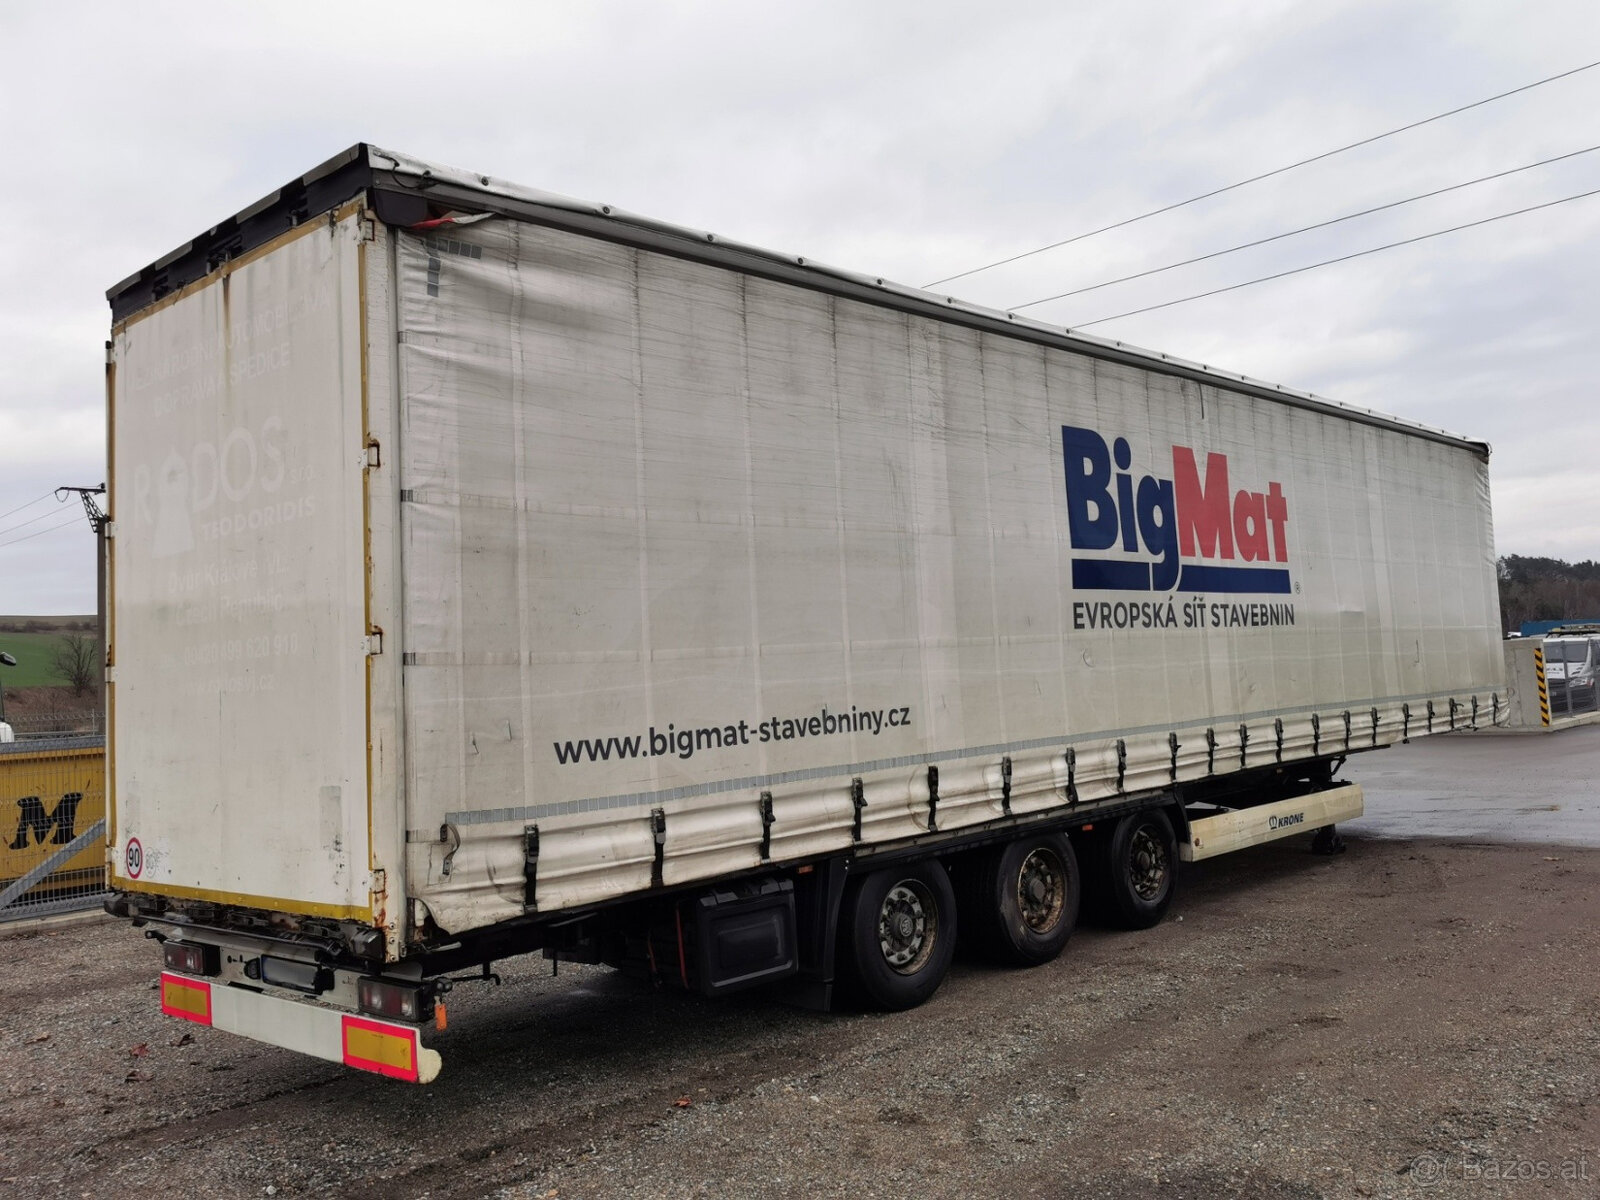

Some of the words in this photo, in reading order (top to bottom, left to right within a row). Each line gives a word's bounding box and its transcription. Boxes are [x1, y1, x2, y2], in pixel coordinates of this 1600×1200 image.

[1061, 425, 1288, 591] BigMat
[1073, 596, 1178, 630] EVROPSKÁ
[1183, 596, 1207, 628] SÍŤ
[1211, 603, 1295, 628] STAVEBNIN
[245, 634, 269, 658] 620
[273, 632, 297, 657] 910
[554, 705, 911, 765] www.bigmat-stavebniny.cz
[9, 792, 83, 850] M
[1278, 813, 1304, 828] KRONE
[128, 847, 140, 867] 90
